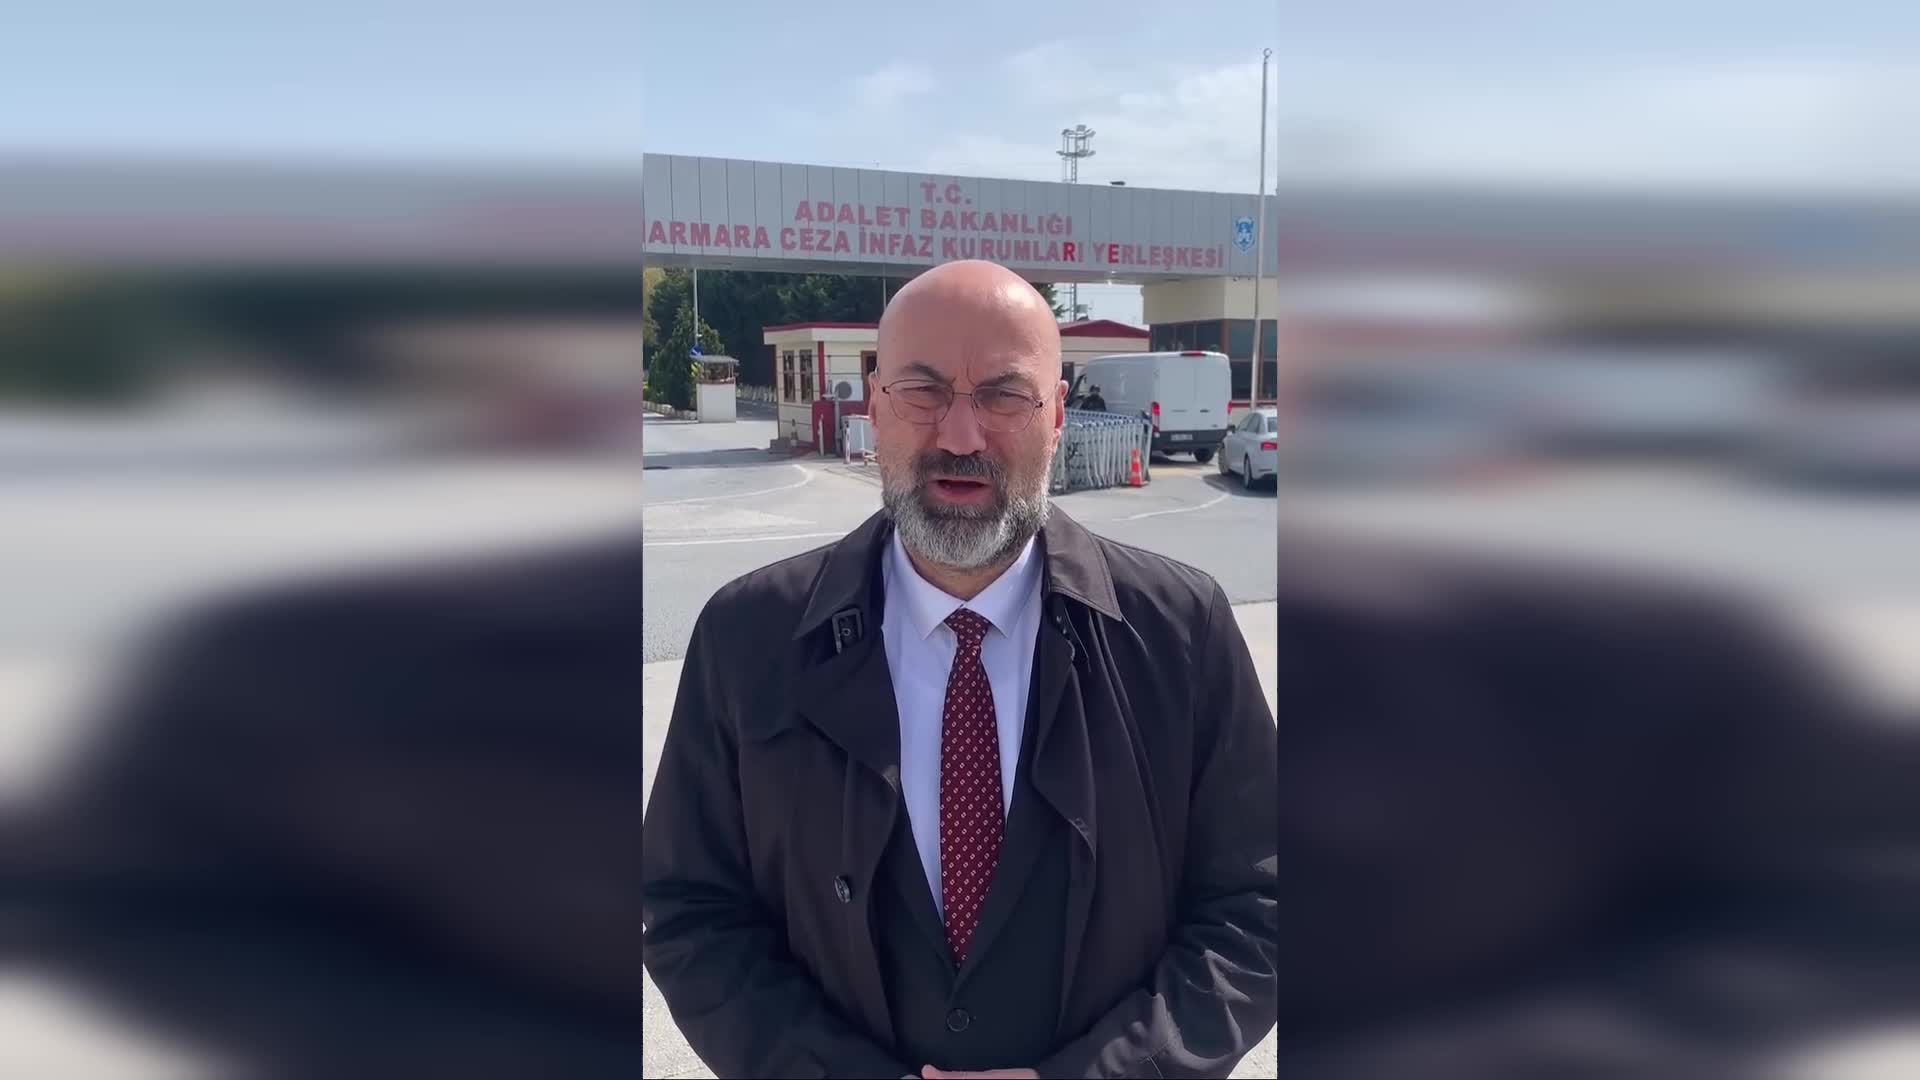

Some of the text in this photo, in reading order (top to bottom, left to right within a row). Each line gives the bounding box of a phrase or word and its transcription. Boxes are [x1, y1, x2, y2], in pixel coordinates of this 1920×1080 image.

[920, 182, 972, 205] T.C.
[795, 201, 1073, 235] ADALET BAKANLIĞI
[643, 220, 1224, 270] ARMARA CEZA İNFAZ KURUMLARI YERLEŞKESİ
